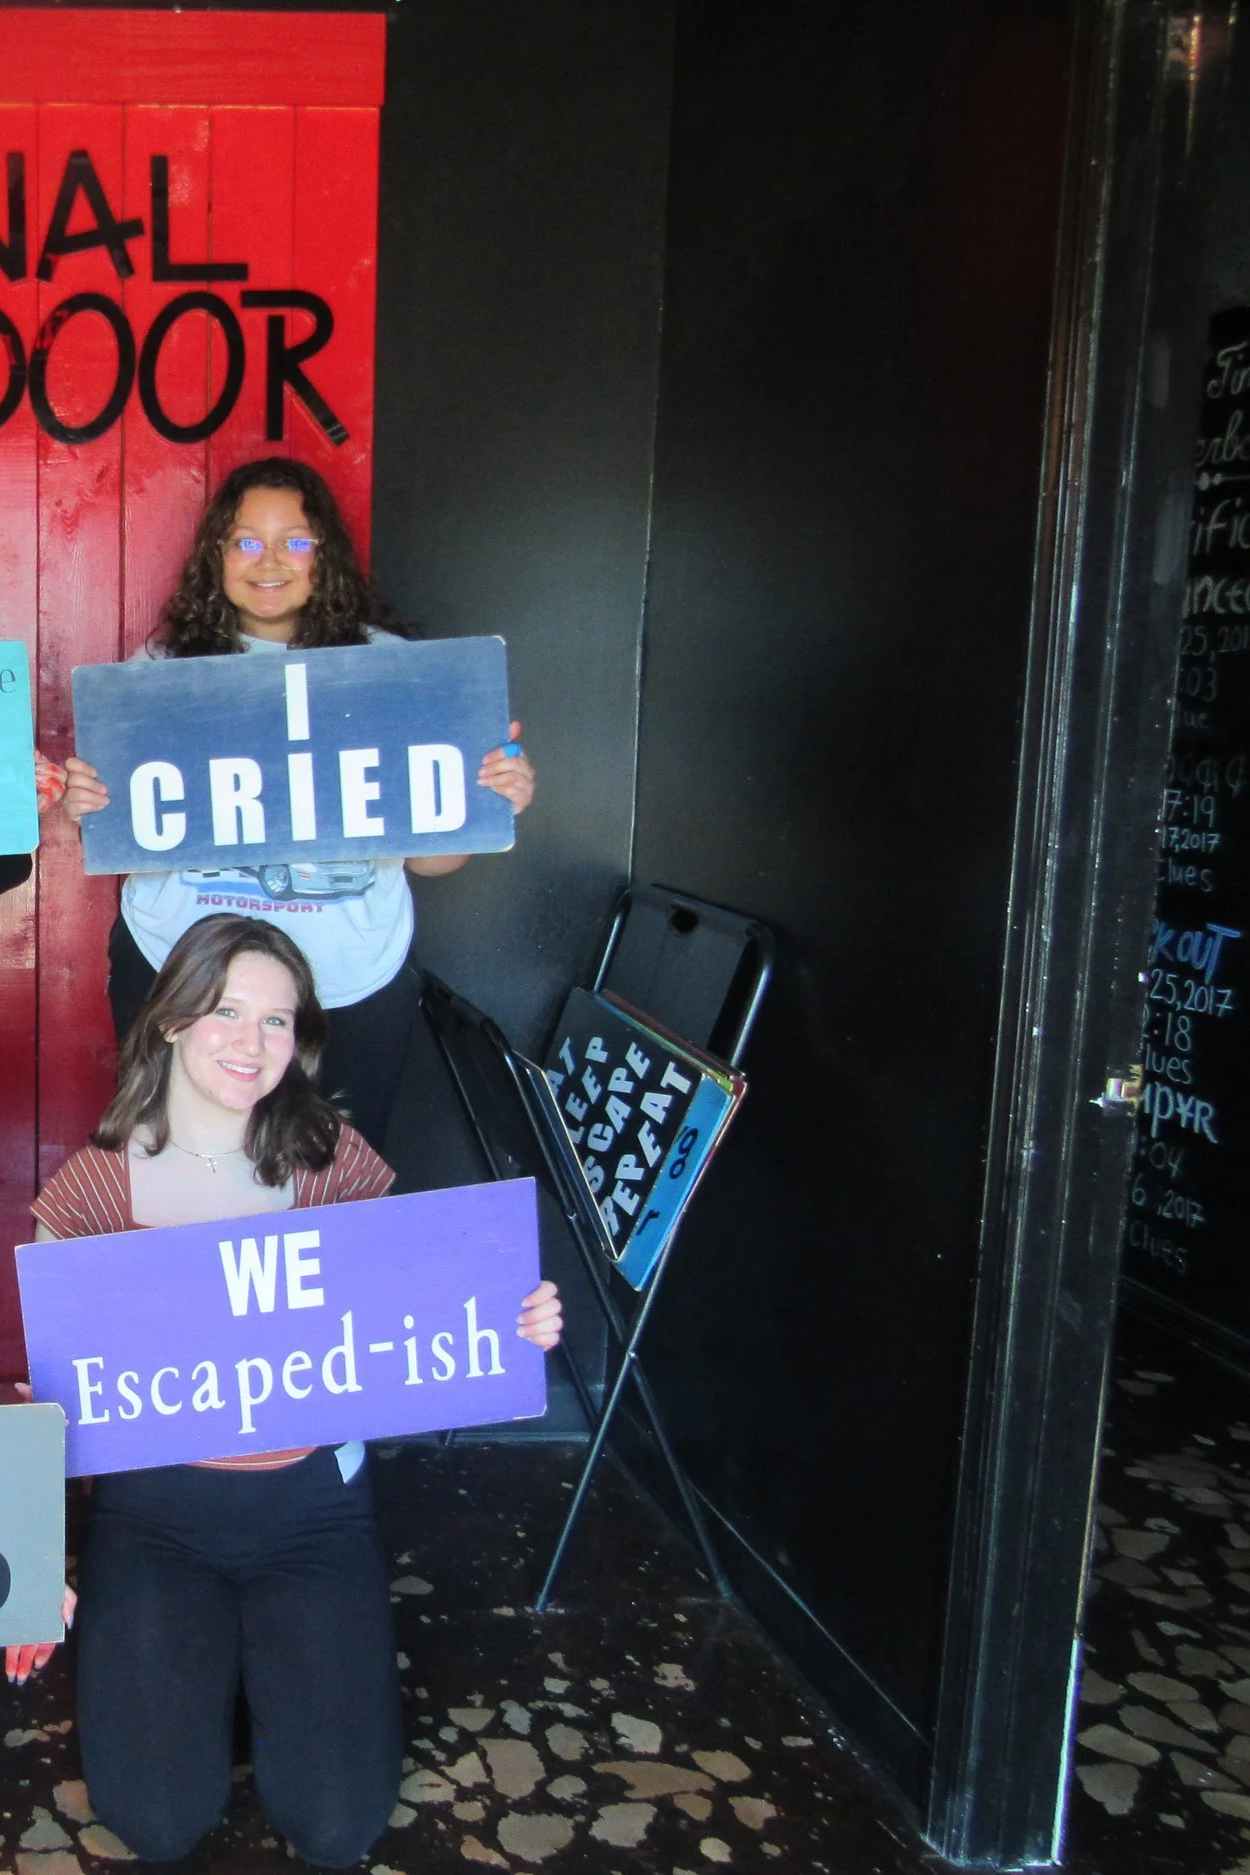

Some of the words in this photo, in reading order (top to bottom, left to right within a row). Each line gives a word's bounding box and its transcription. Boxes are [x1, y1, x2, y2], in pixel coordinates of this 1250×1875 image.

[284, 663, 310, 741] I
[129, 744, 467, 852] CRIED
[196, 894, 324, 913] MOTORSPORT
[546, 1037, 576, 1100] AT
[565, 1036, 608, 1144] LEEP
[584, 1041, 651, 1194] SCAPE
[218, 1229, 325, 1317] WE
[72, 1296, 507, 1435] Escaped-ish
